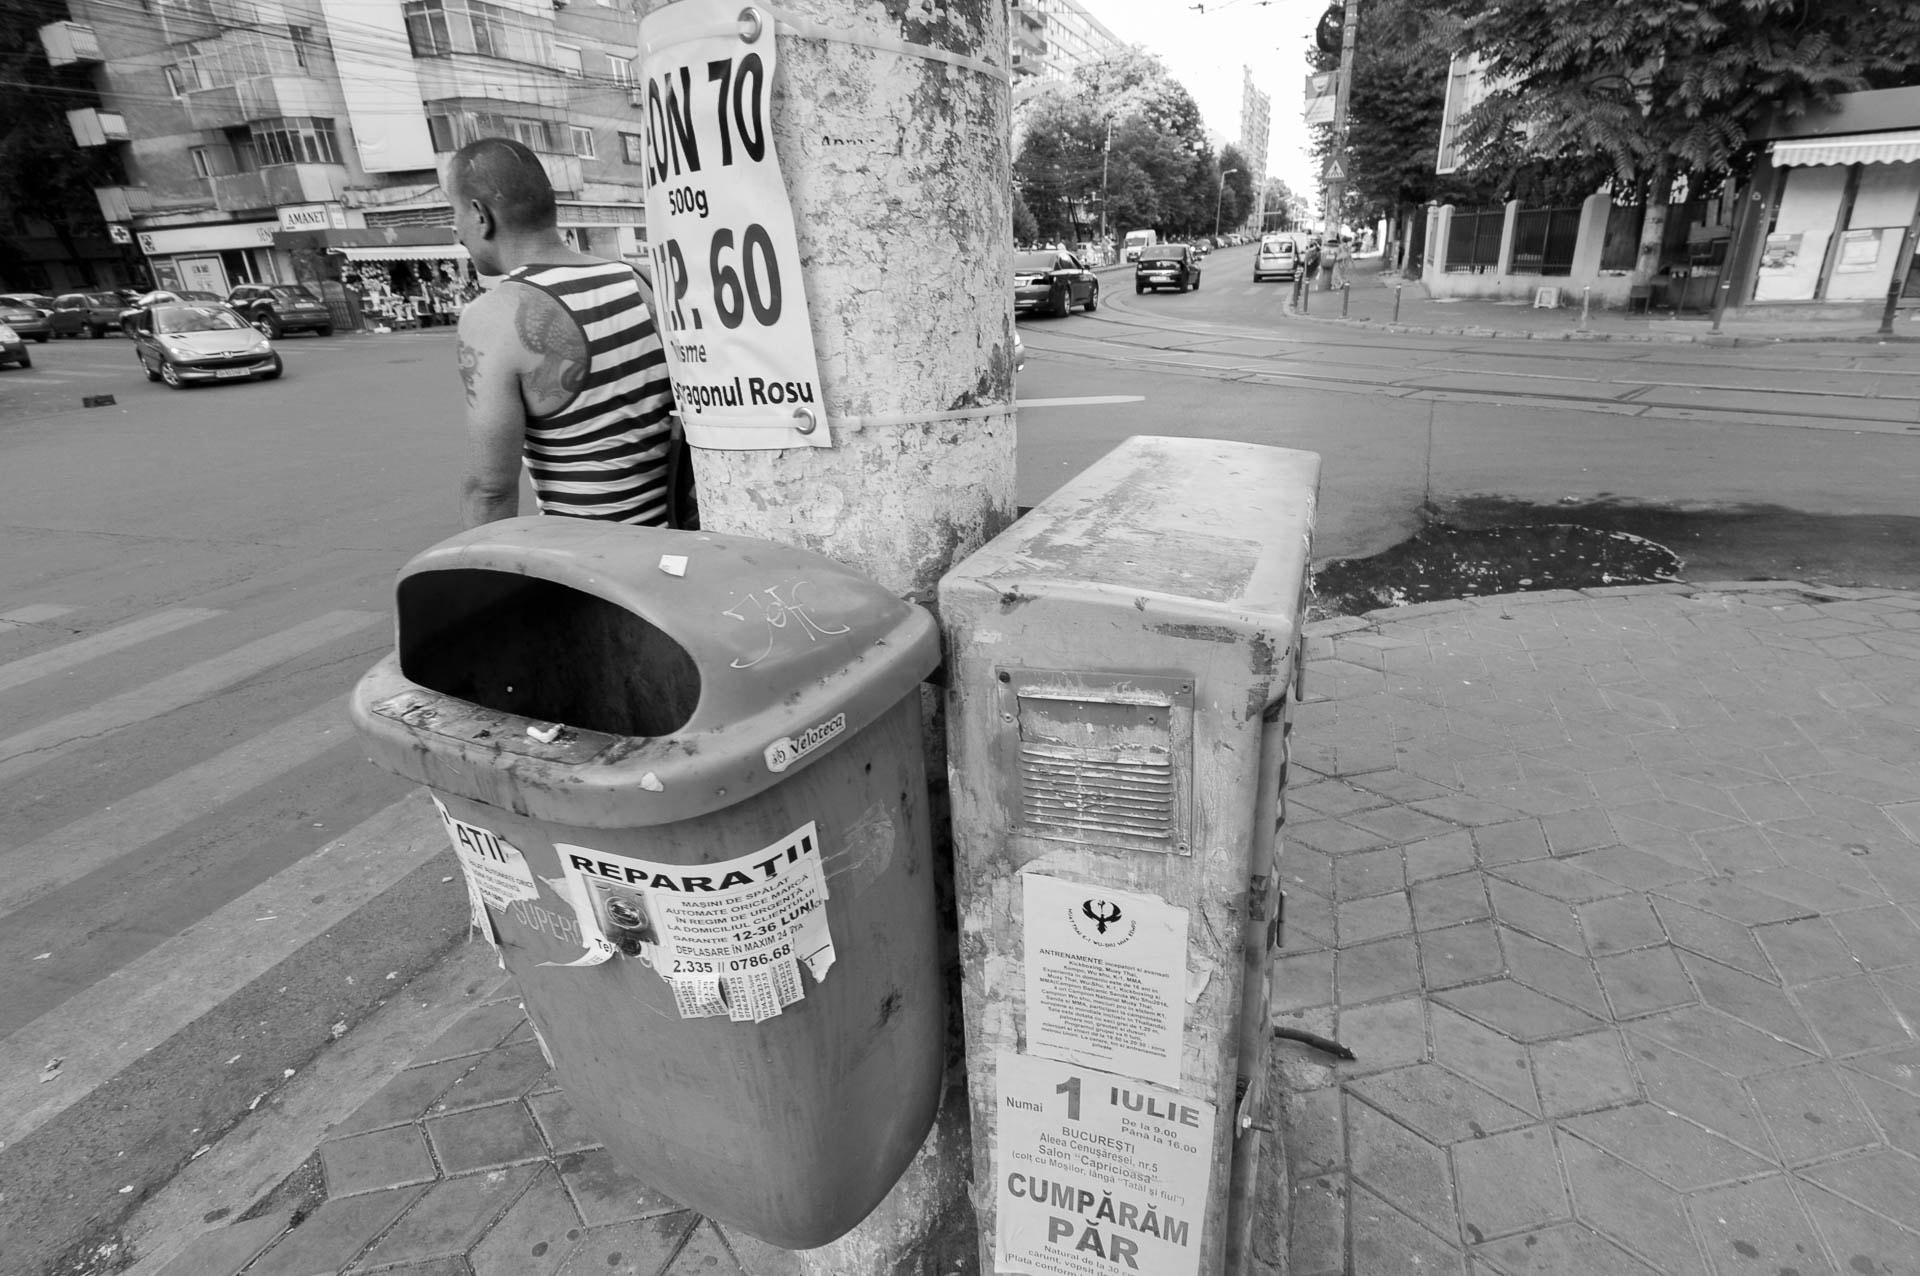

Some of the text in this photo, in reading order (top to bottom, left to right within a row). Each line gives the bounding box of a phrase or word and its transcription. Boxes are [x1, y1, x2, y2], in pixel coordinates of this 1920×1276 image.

[708, 53, 765, 167] 70
[669, 186, 709, 218] 500g
[288, 211, 326, 225] AMANET
[710, 223, 782, 329] 60
[749, 377, 814, 406] Rosu
[789, 716, 844, 754] Veloteca
[569, 835, 813, 893] REPARAŢII
[666, 908, 728, 916] AUTOMATE
[731, 899, 768, 913] ORICE
[683, 922, 751, 933] DOMICILIUL
[753, 888, 815, 925] CLIENTULUI
[726, 896, 742, 905] DE
[689, 917, 728, 925] REGIM
[730, 913, 747, 922] DE
[732, 922, 776, 942] 12-36
[781, 899, 815, 926] LUNI
[675, 945, 731, 957] DEPLASARE
[744, 935, 776, 952] MAXIM
[777, 929, 787, 941] 24
[1006, 1076, 1200, 1128] Numai 1 IULIE
[1062, 1126, 1135, 1154] BUCUREŞTI
[1121, 1117, 1178, 1139] De la 9.00
[1039, 1144, 1071, 1160] Salon
[1040, 1132, 1067, 1147] Aleea
[1138, 1160, 1158, 1173] nr.5
[1153, 1134, 1163, 1144] la
[1167, 1139, 1197, 1154] 16.00
[1035, 1155, 1046, 1165] cu
[1008, 1172, 1189, 1247] CUMPĂRĂM
[1048, 1216, 1139, 1270] PĂR
[1044, 1245, 1079, 1260] Natural
[1081, 1257, 1094, 1265] de
[1096, 1261, 1105, 1270] la
[1065, 1261, 1094, 1275] vopsit
